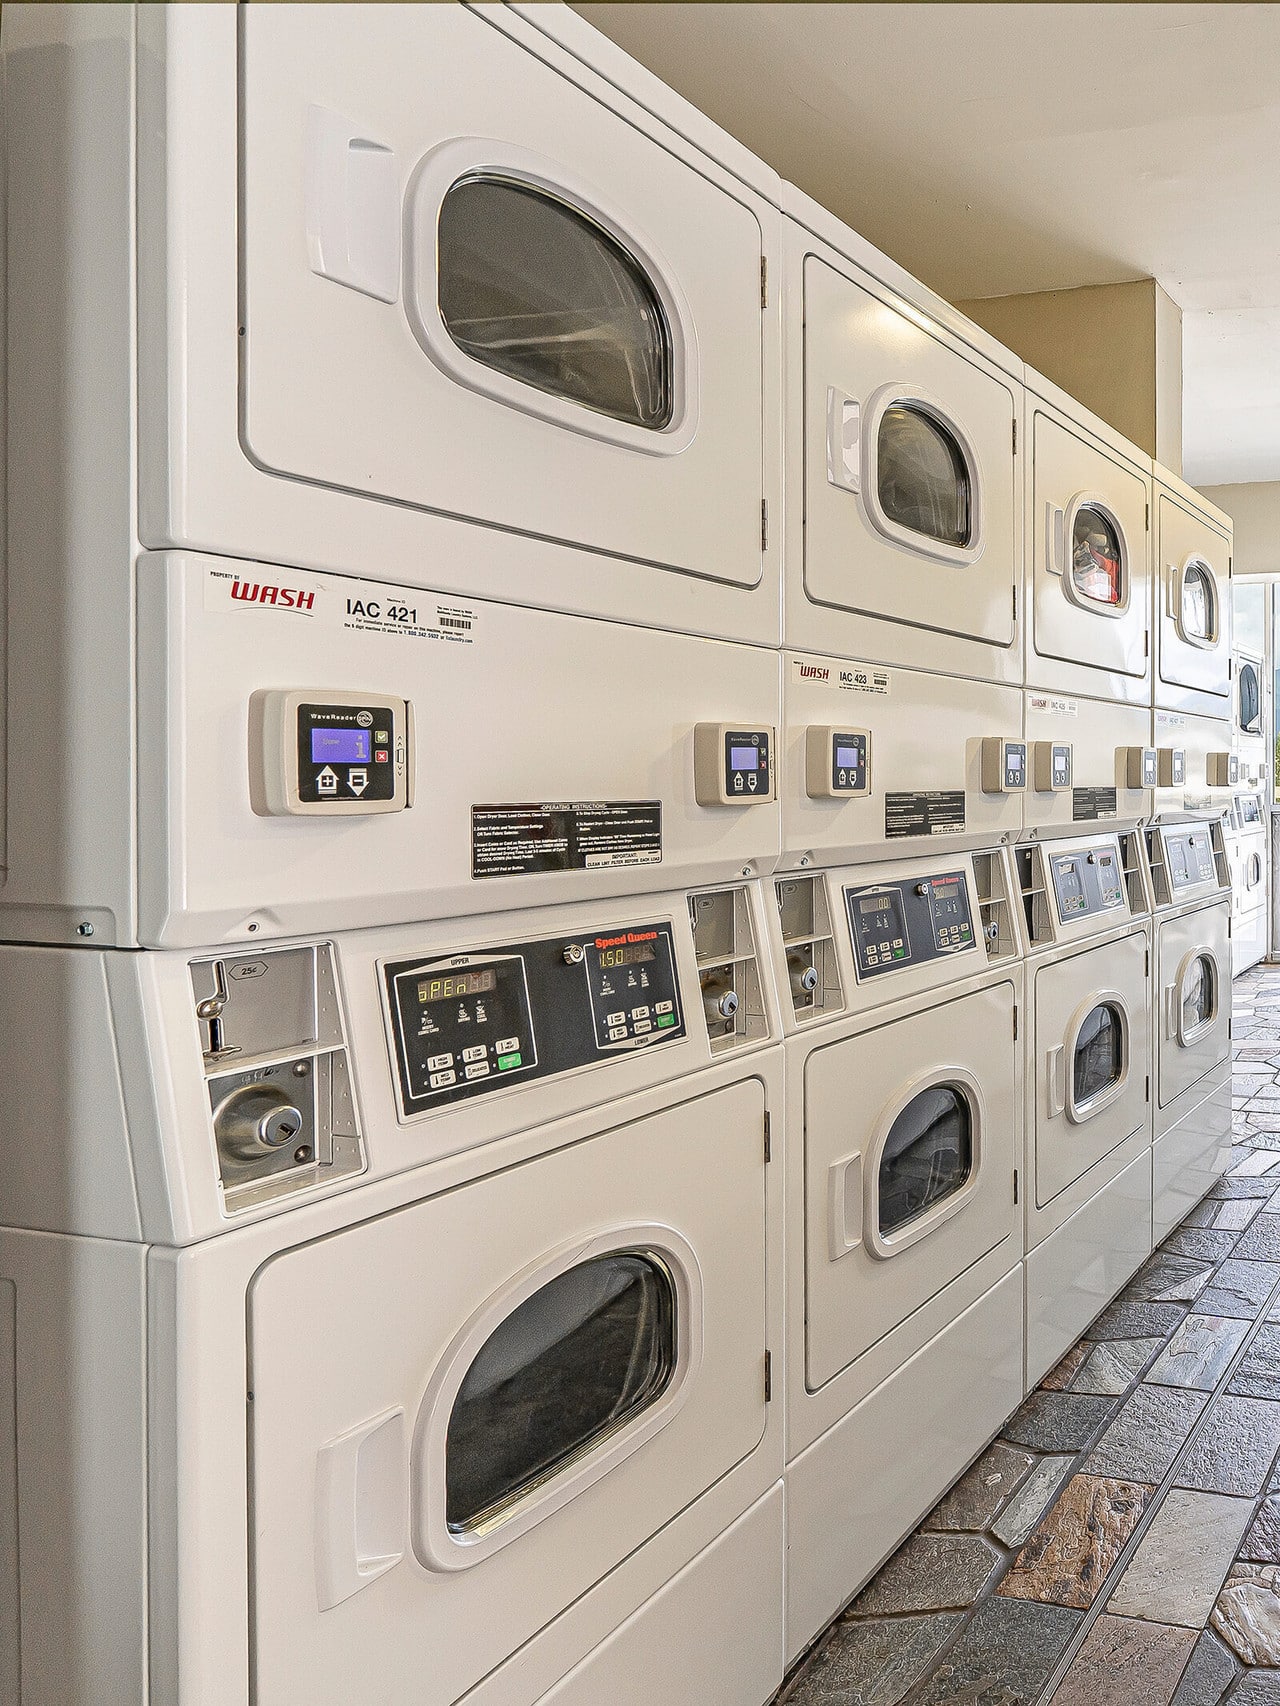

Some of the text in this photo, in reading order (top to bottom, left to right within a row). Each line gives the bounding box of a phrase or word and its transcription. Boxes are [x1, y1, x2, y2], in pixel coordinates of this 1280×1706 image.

[231, 581, 315, 610] WASH
[346, 599, 380, 618] IAC
[387, 606, 417, 623] 421
[800, 665, 829, 680] WASH
[840, 672, 853, 682] IAC
[855, 674, 867, 684] 423
[311, 713, 357, 721] WaveReader
[595, 931, 658, 949] Speed Queen
[450, 957, 470, 966] UPPER
[635, 1037, 649, 1045] LOWER
